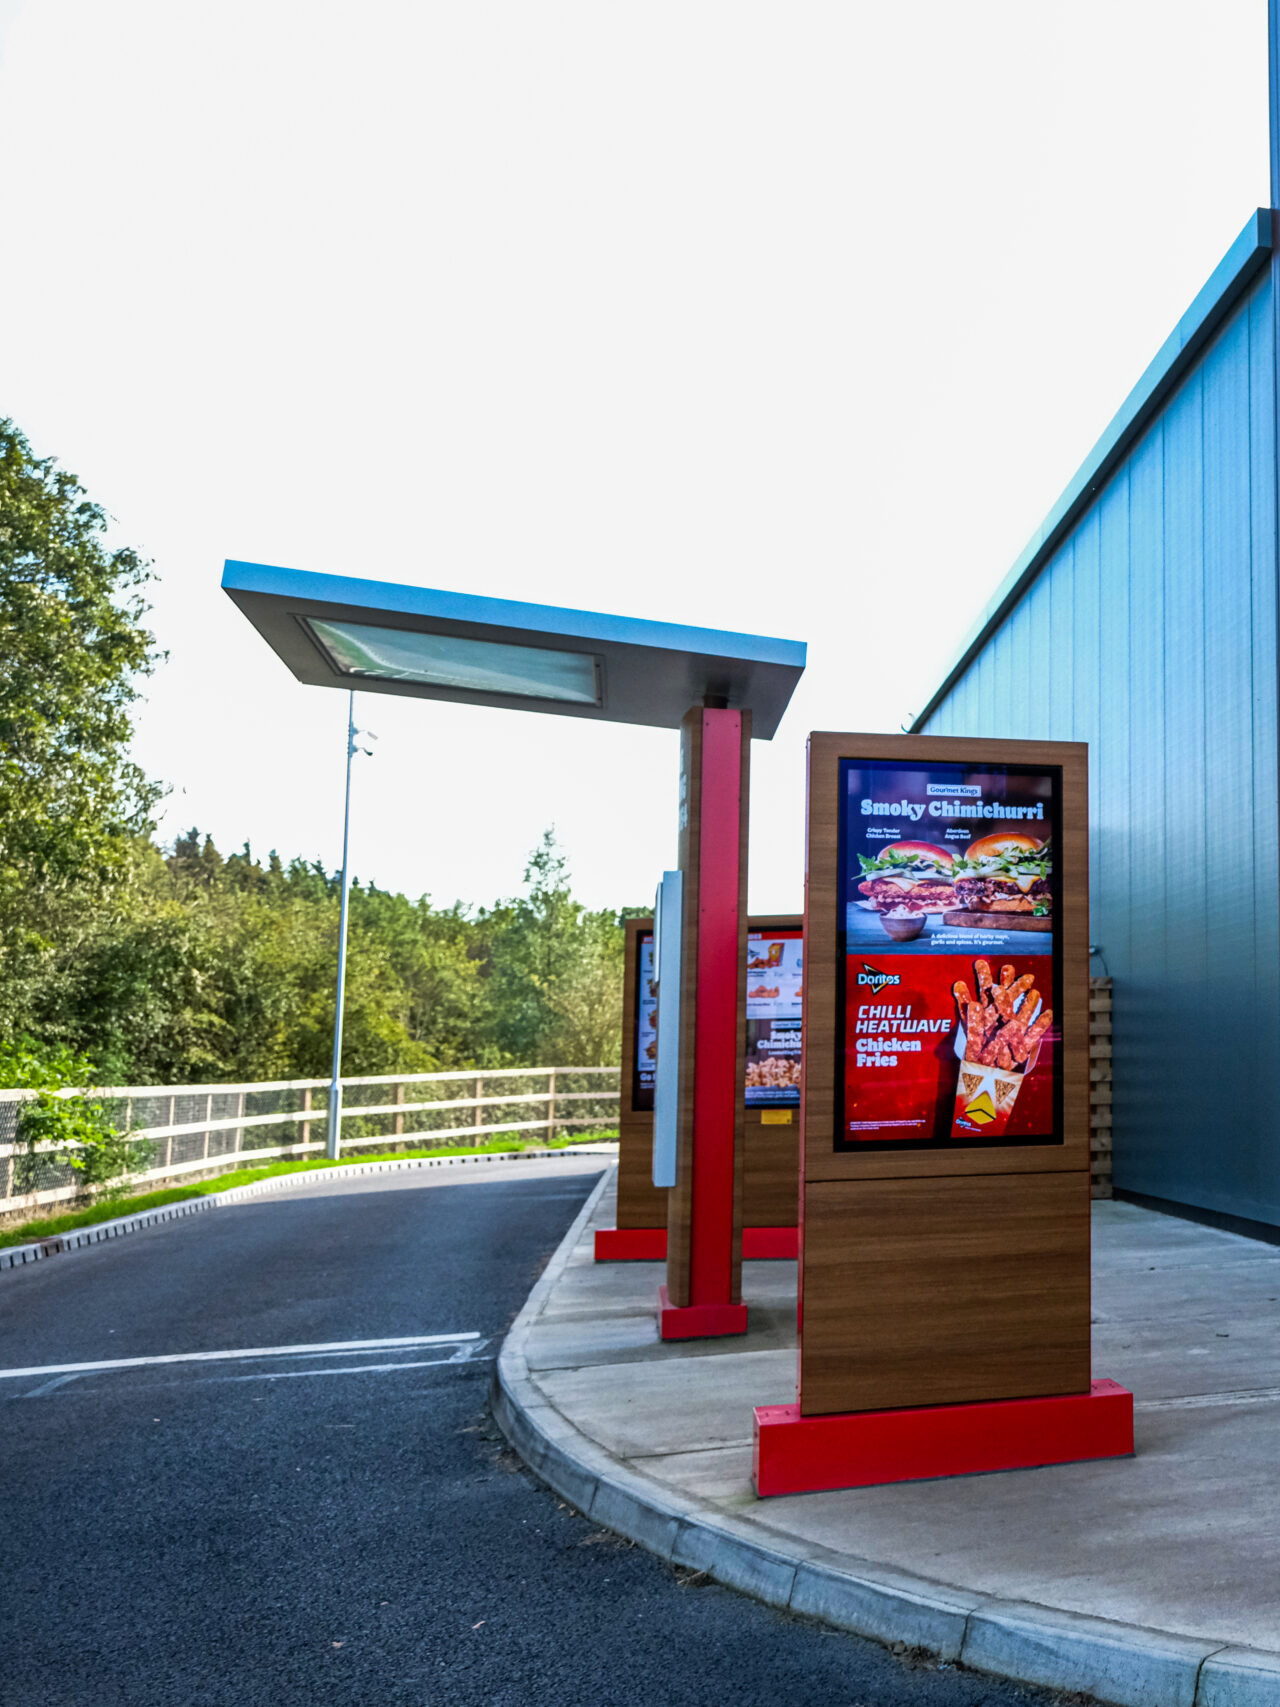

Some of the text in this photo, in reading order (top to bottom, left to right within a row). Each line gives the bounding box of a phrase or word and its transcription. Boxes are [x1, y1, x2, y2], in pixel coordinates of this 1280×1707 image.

[929, 786, 979, 796] Gourmet Kings
[860, 799, 1044, 821] Smoky Chimichurri
[857, 972, 901, 985] Doritos
[858, 1005, 912, 1018] CHILLI
[855, 1019, 952, 1033] HEATWAVE
[855, 1037, 922, 1052] Chicken
[856, 1052, 898, 1067] Fries
